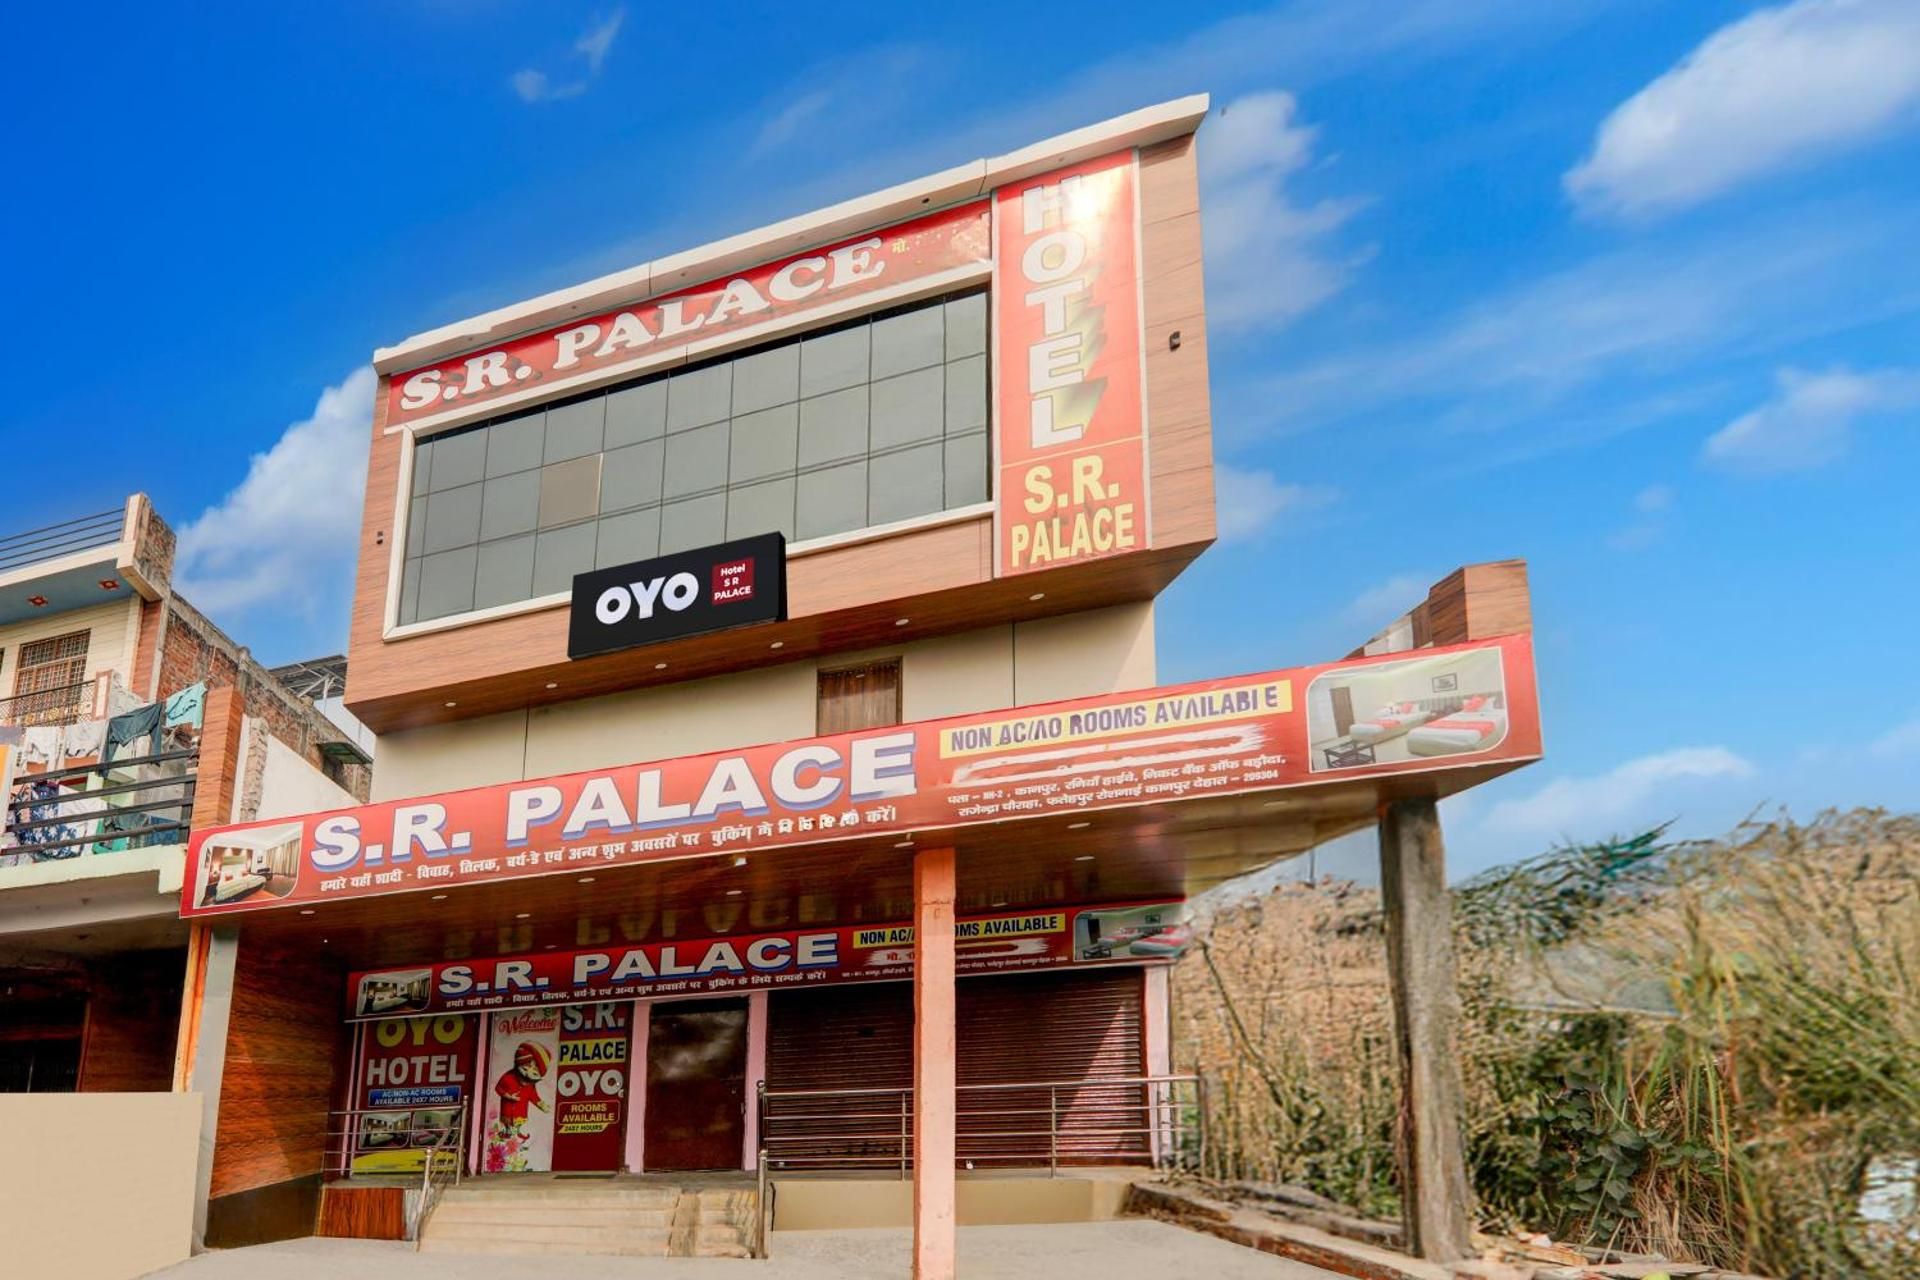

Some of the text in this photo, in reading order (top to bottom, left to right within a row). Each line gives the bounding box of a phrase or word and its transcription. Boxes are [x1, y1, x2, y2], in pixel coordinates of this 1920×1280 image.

[401, 237, 886, 411] S.R. PALACE
[1021, 175, 1087, 449] HOTEL
[1023, 454, 1120, 514] S.R.
[1010, 503, 1135, 567] PALACE
[720, 563, 746, 577] Hotel
[595, 571, 700, 625] OYO
[714, 585, 752, 601] PALACE
[951, 727, 992, 752] NON
[1069, 705, 1147, 736] ROOMS
[311, 732, 918, 868] S.R. PALACE
[860, 931, 886, 945] NON
[984, 915, 1058, 935] AVAILABLE
[438, 933, 838, 996] S.R. PALACE
[377, 1014, 465, 1048] OYO
[560, 1041, 625, 1062] PALACE
[366, 1054, 466, 1086] HOTEL
[557, 1069, 624, 1097] OYO
[562, 1112, 615, 1123] AVAILABLE
[570, 1103, 608, 1113] ROOMS
